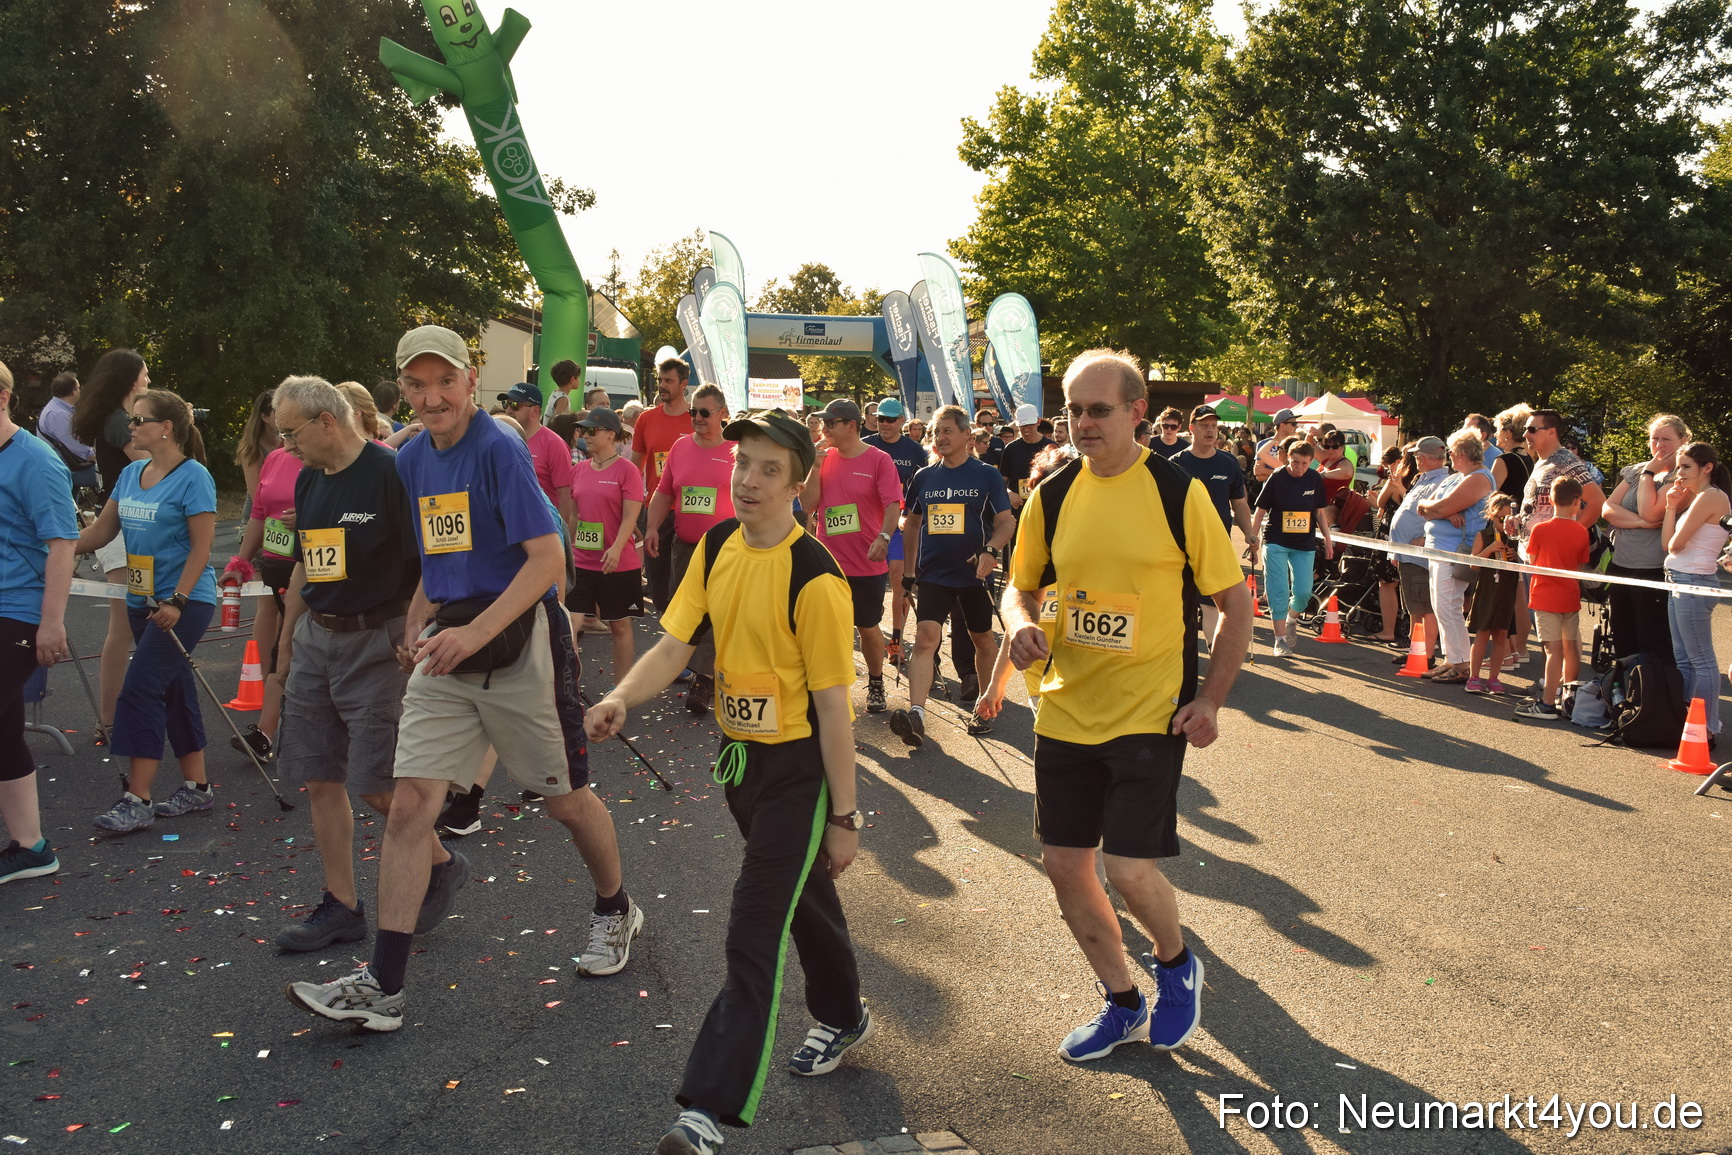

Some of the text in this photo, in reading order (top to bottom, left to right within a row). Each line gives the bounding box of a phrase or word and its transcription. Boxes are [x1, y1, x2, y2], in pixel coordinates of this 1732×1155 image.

[474, 102, 551, 207] AOK
[796, 335, 844, 346] firmenlauf
[924, 488, 979, 499] EURO POLES
[684, 495, 711, 507] 2079
[428, 513, 465, 537] 1096
[826, 514, 853, 528] 2057
[933, 514, 955, 526] 533
[1286, 518, 1307, 527] 1123
[265, 529, 290, 547] 2060
[577, 530, 599, 543] 2058
[1071, 609, 1128, 638] 1662
[1096, 636, 1121, 644] Günther
[720, 691, 768, 721] 1687
[736, 720, 761, 728] Michael
